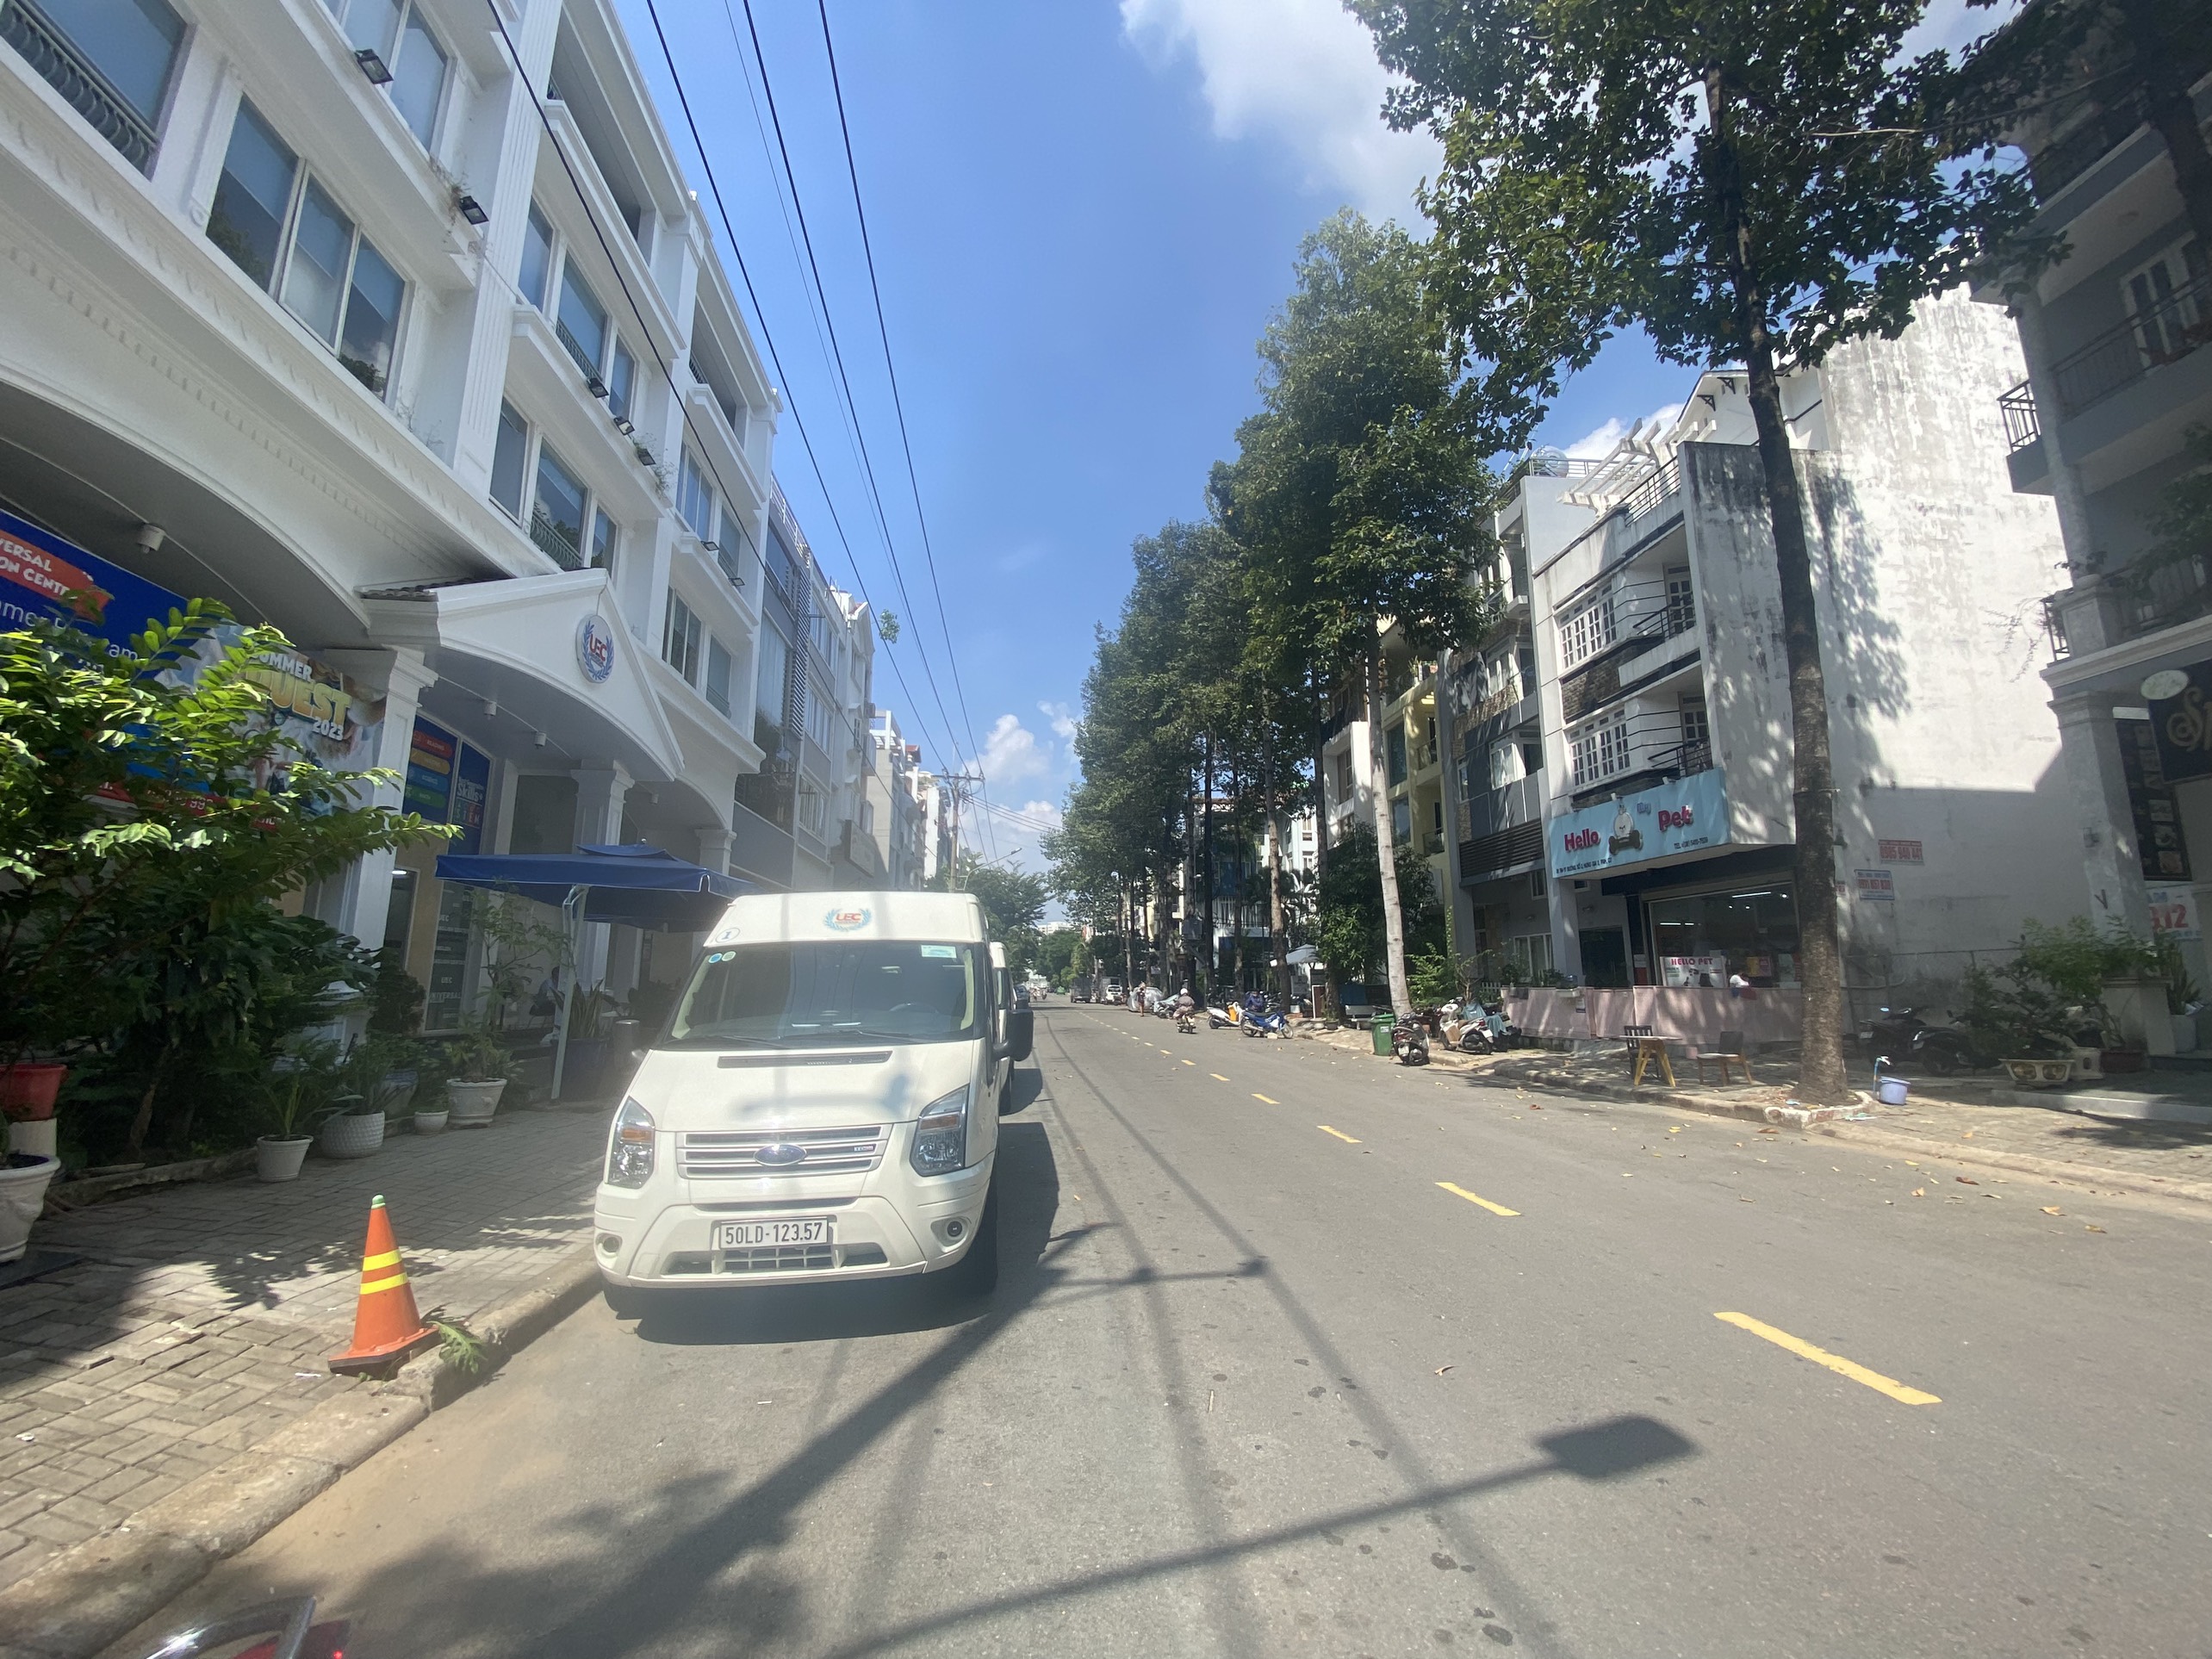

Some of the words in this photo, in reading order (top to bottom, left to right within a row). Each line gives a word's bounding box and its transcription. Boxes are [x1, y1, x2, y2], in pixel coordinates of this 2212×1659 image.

[589, 633, 607, 662] UEC
[252, 652, 313, 682] UMMER
[313, 716, 344, 741] 2023
[1563, 828, 1600, 853] Hello
[1658, 805, 1693, 832] Pet
[836, 912, 861, 922] UEC
[725, 1221, 823, 1245] 50LD-123.57
